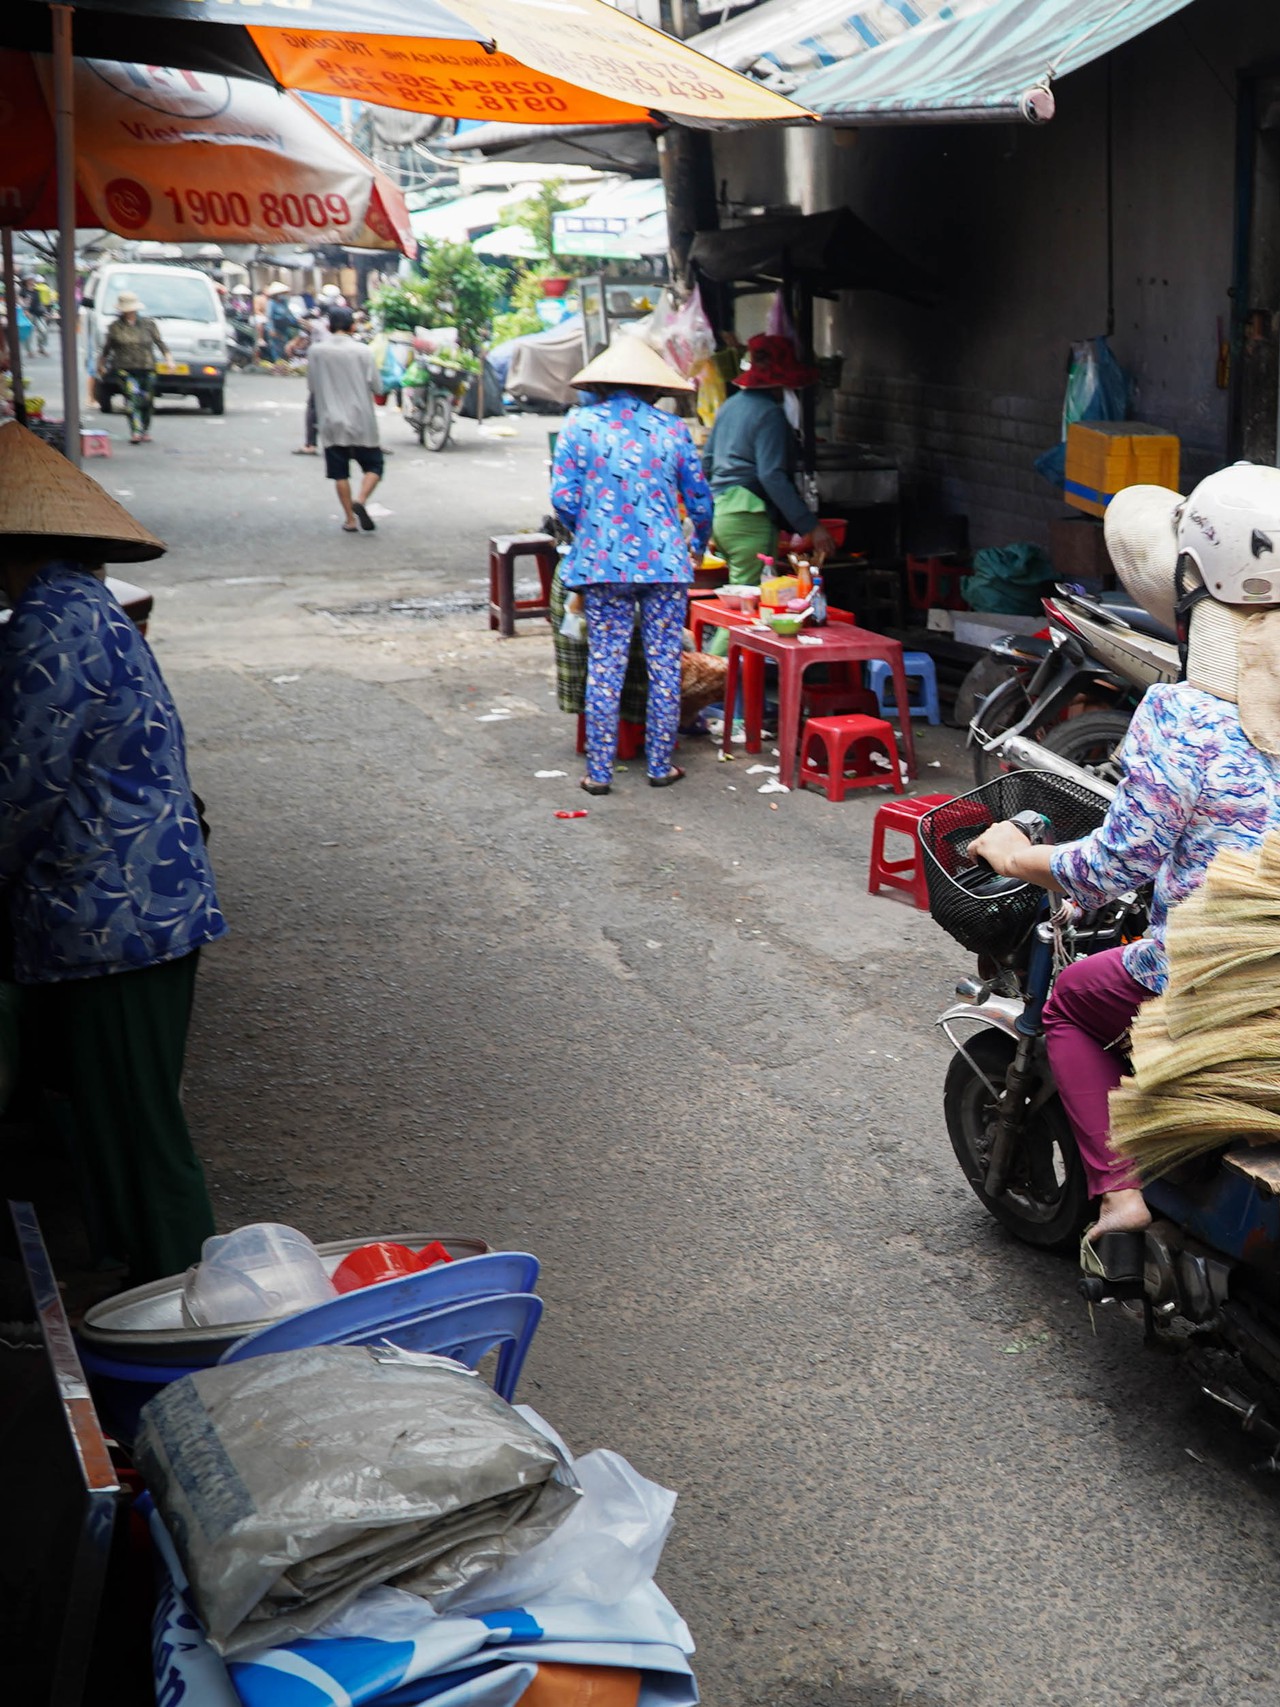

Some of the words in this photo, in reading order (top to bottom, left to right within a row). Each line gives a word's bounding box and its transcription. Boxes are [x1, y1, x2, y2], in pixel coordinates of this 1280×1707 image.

[667, 80, 725, 101] 439
[164, 186, 250, 227] 1900
[259, 193, 352, 228] 8009
